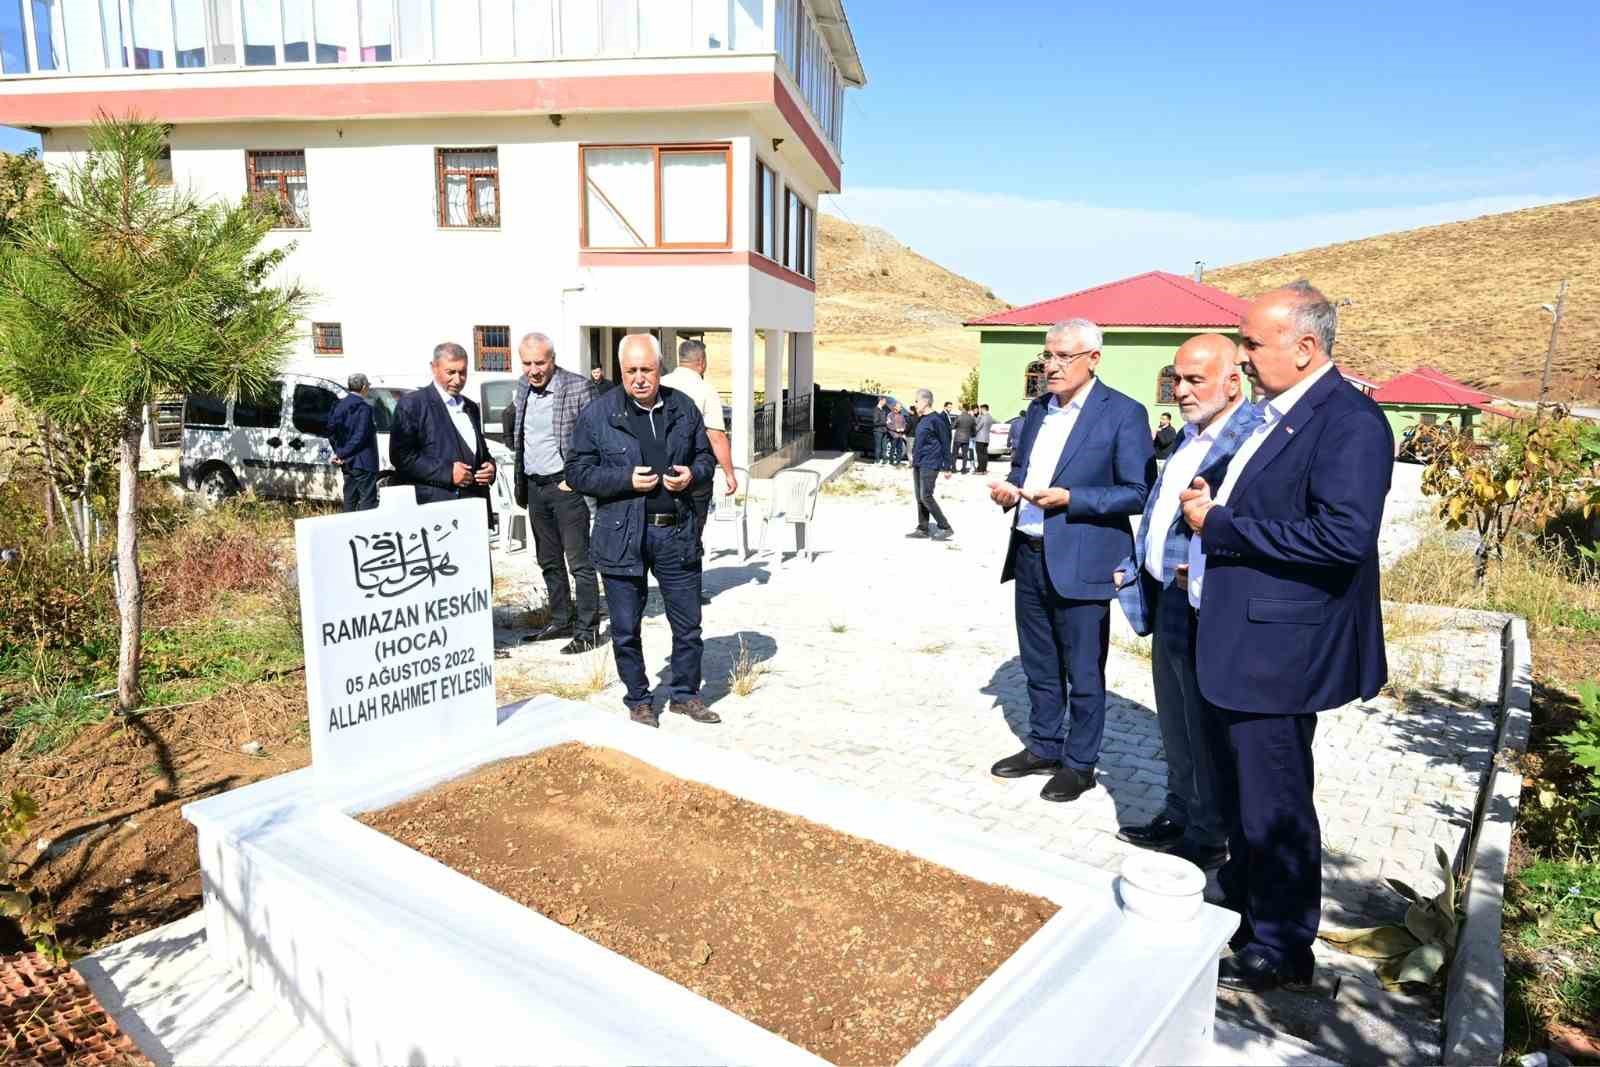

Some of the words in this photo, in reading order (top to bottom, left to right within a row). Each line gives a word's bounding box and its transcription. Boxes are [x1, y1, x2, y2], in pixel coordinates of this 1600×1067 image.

[322, 604, 419, 647] RAMAZAN
[424, 587, 488, 623] KESKİN
[345, 675, 364, 695] 05
[368, 655, 441, 689] AĞUSTOS
[444, 647, 475, 670] 2022
[374, 626, 448, 663] (HOCA)
[328, 696, 377, 732] ALLAH
[381, 679, 438, 716] RAHMET
[440, 661, 493, 700] EYLESİN
